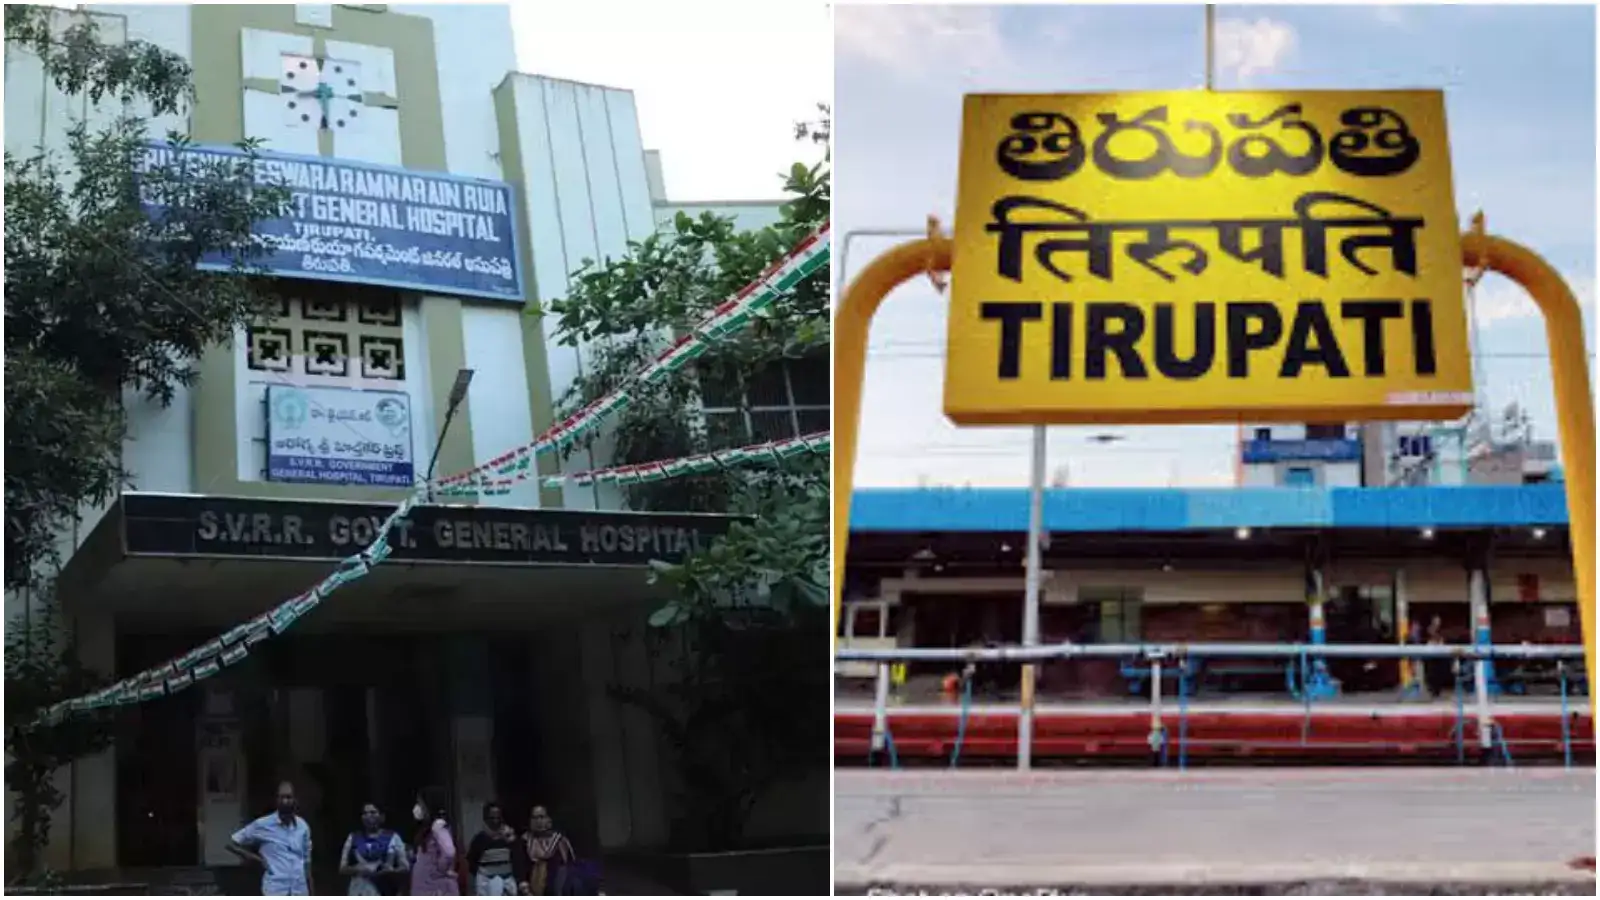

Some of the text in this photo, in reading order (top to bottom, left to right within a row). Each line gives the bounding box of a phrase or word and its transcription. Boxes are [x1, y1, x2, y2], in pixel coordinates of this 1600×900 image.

[996, 102, 1420, 182] తిరుపతి
[313, 195, 404, 231] GENERAL
[406, 206, 500, 242] HOSPITAL
[464, 184, 507, 215] RUIA
[985, 191, 1426, 282] तिरुपति
[979, 299, 1437, 381] TIRUPATI
[271, 467, 317, 479] GENERAL
[329, 459, 393, 472] GOVERNMENT
[198, 510, 314, 545] S.V.R.R.
[433, 520, 568, 553] GENERAL
[580, 522, 702, 555] HOSPITAL
